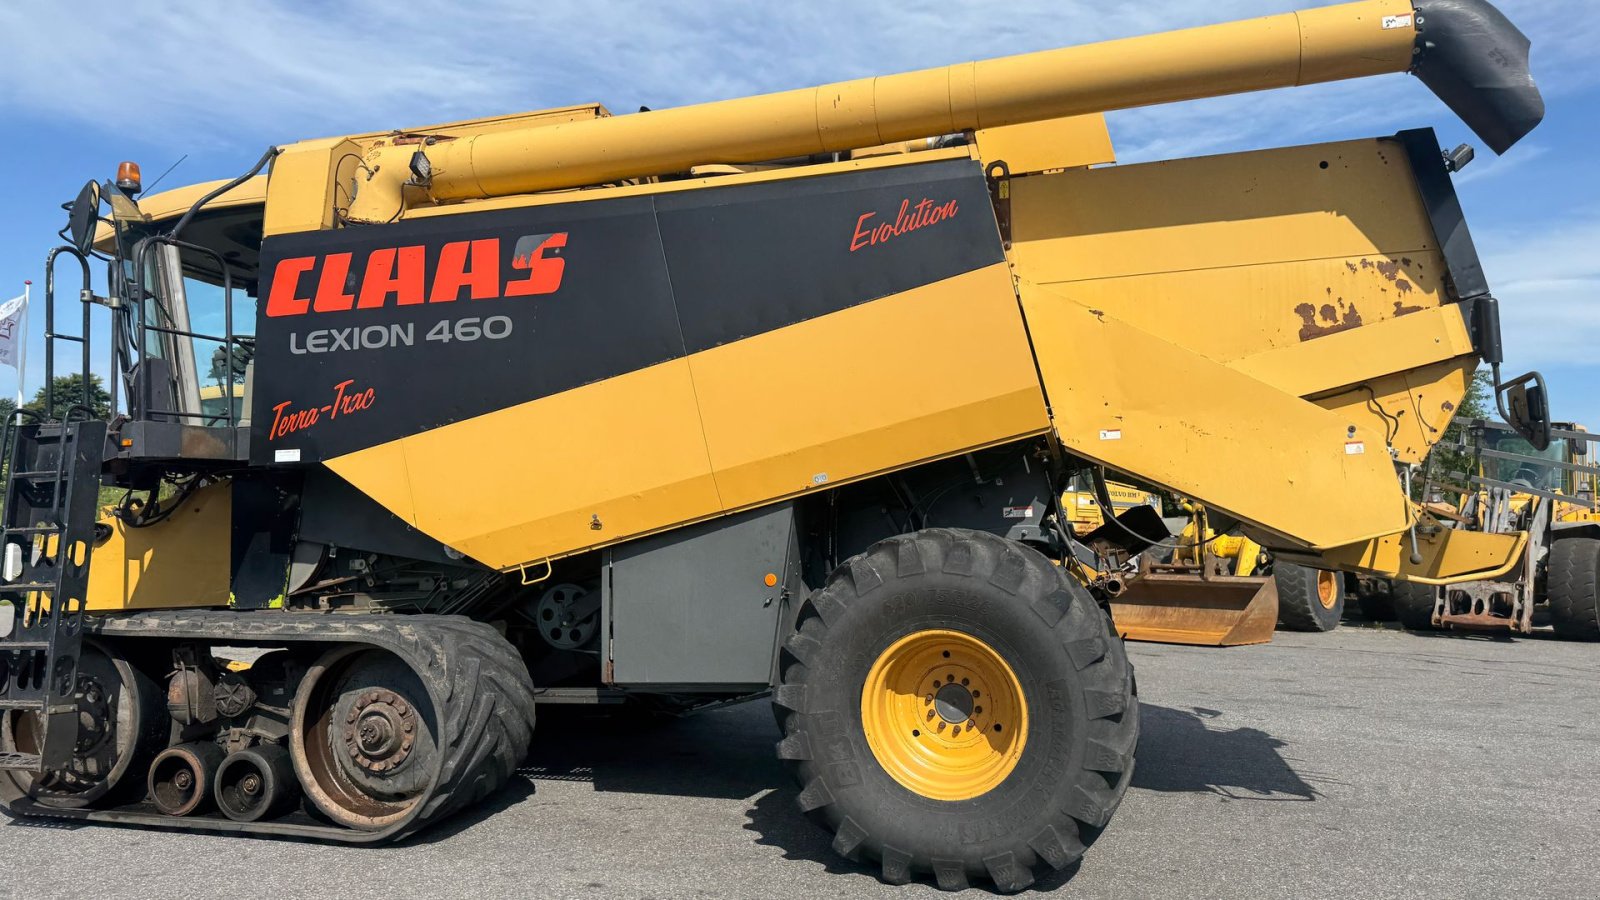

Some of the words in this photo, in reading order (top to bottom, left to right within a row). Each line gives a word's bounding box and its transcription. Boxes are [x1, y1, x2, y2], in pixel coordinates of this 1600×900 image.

[850, 198, 955, 252] Evolution
[265, 231, 568, 318] CLAAS
[289, 322, 415, 355] LEXION
[425, 315, 513, 343] 460
[269, 379, 375, 440] Terra-Trac
